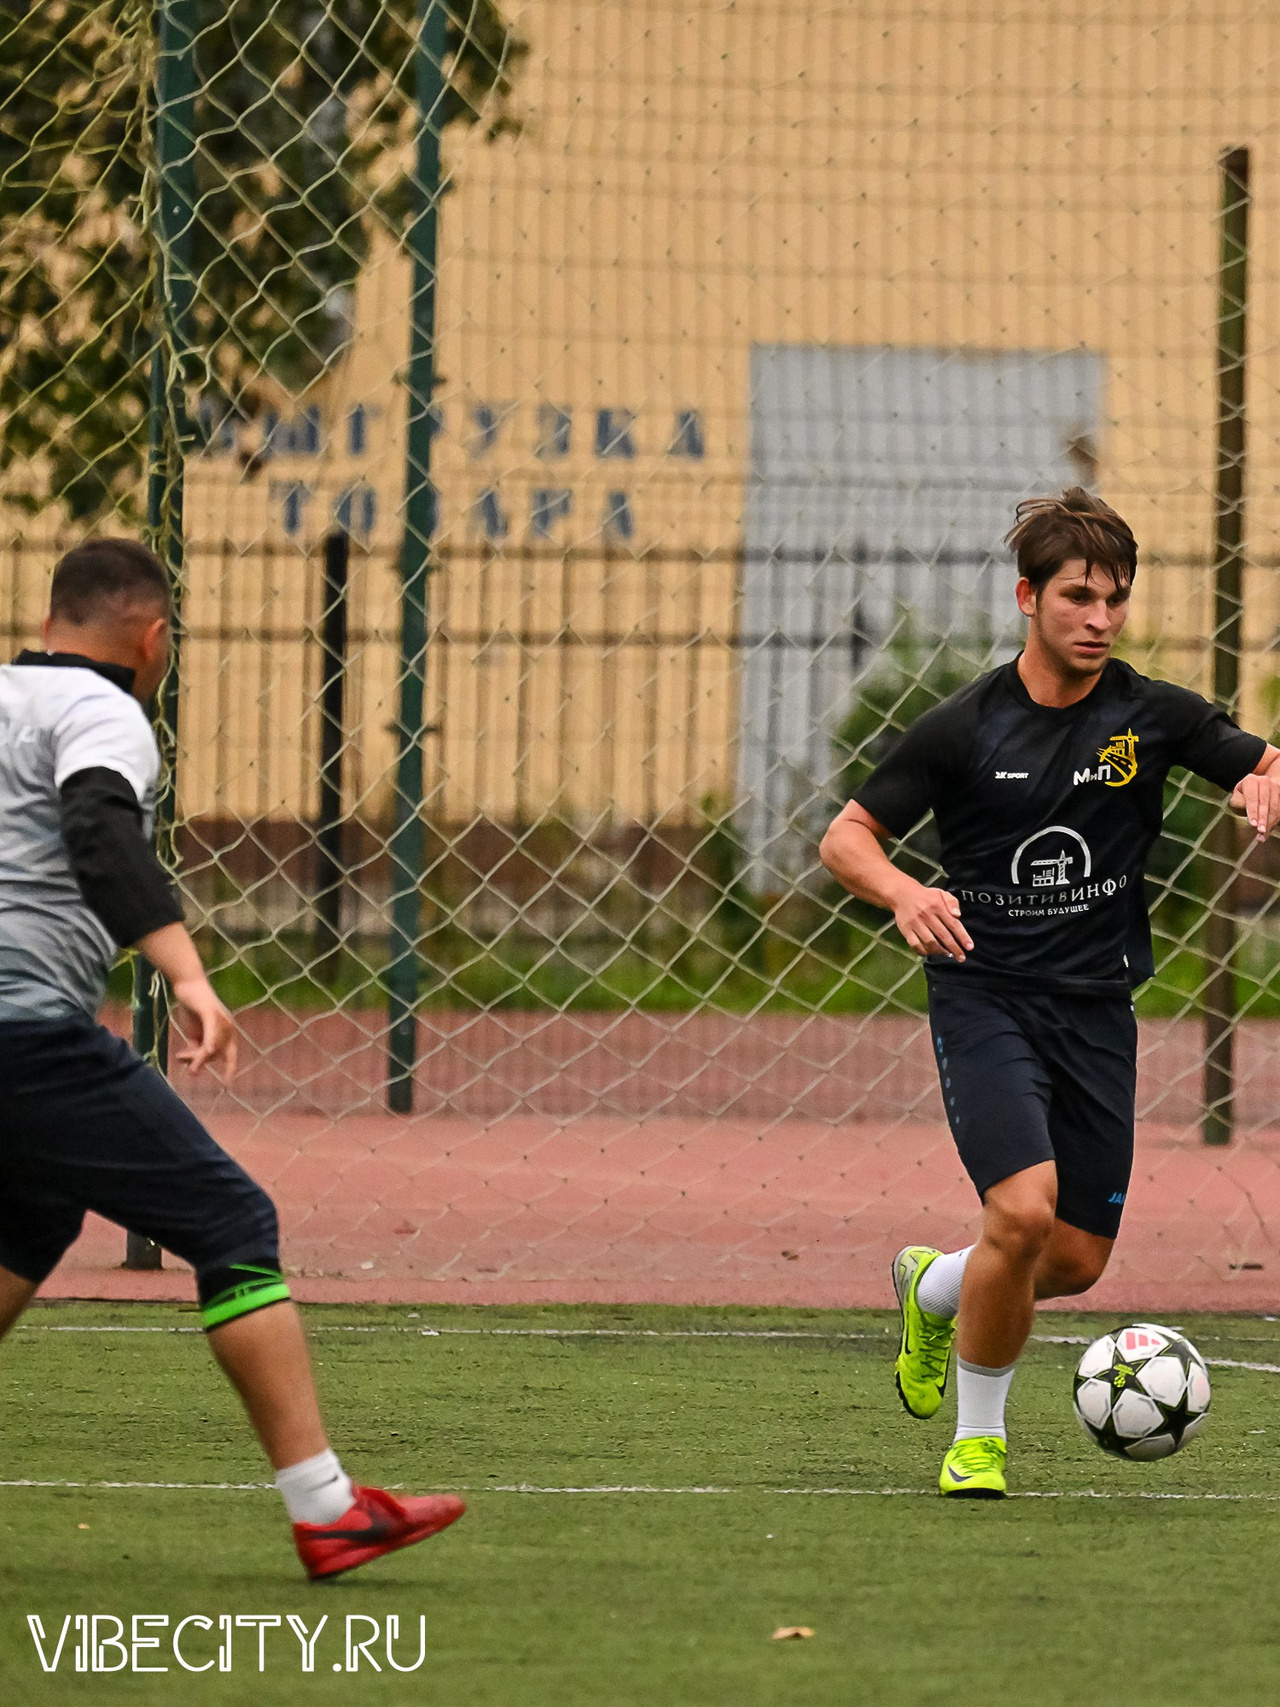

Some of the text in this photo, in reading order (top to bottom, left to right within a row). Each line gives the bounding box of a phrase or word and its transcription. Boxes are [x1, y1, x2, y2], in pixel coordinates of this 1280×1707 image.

[196, 398, 707, 457] ЫГУЗКА
[268, 480, 635, 538] ТОАРА
[1073, 764, 1111, 786] МиП
[961, 874, 1127, 906] ПОЗИТИВИНФО
[1008, 903, 1090, 917] СТРОИМ БУДУЩЕЕ
